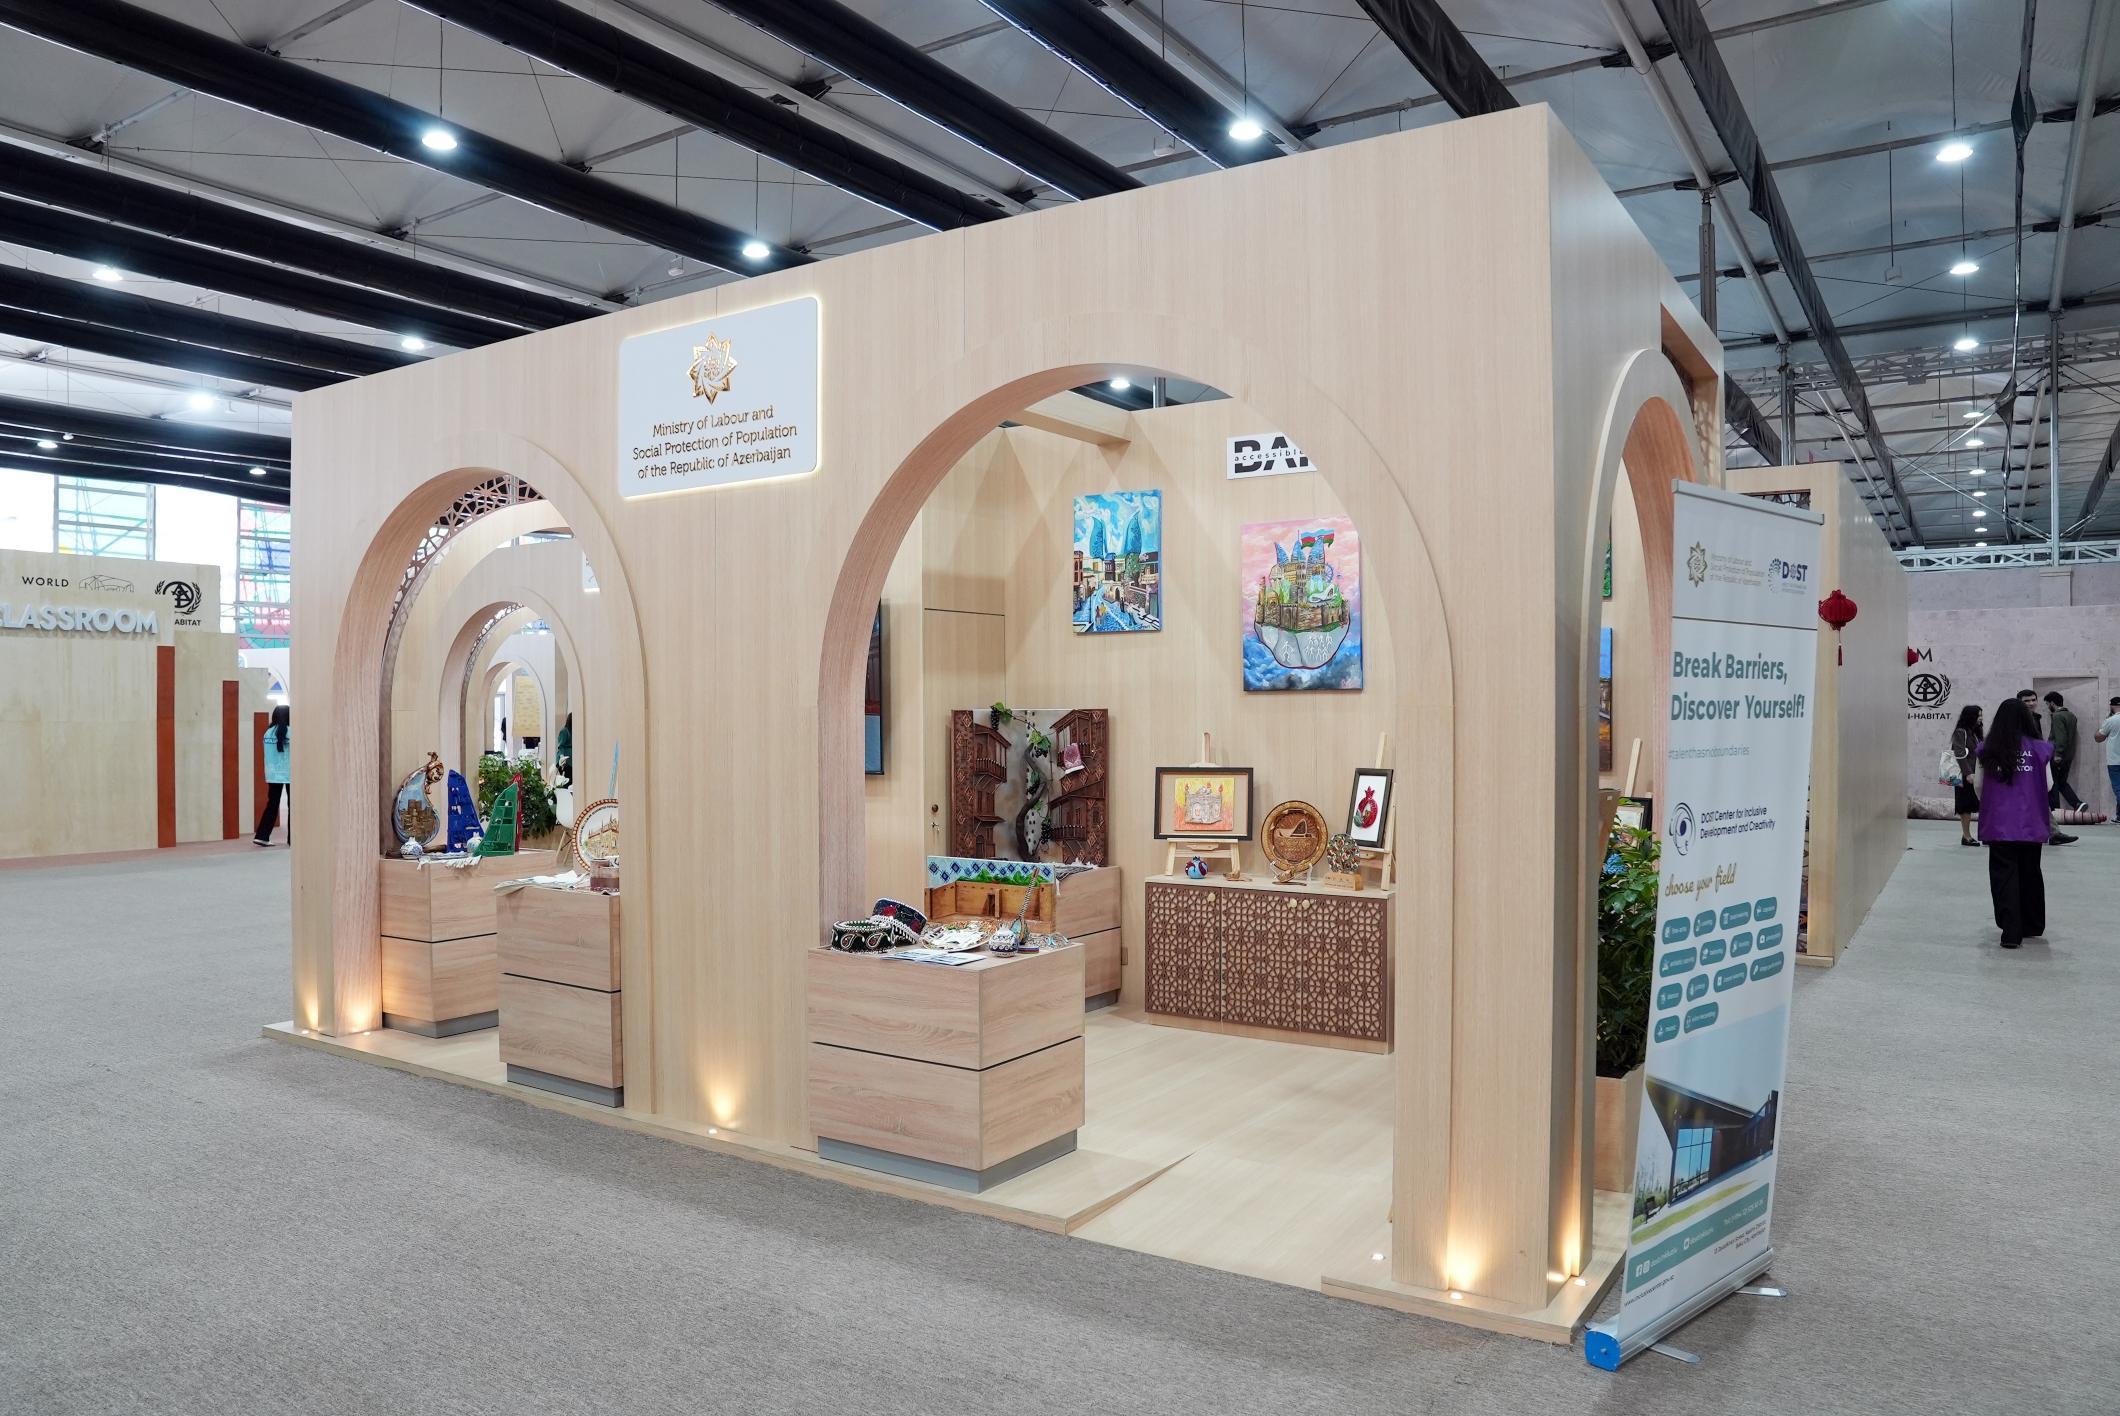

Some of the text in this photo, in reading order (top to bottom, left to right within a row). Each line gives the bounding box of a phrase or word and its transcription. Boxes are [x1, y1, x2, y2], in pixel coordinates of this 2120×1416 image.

[652, 405, 774, 437] Ministry of Labour and
[632, 424, 798, 461] Social Protection of Population
[637, 446, 791, 480] of the Republic of Azerbaijan
[22, 576, 69, 588] WORLD
[0, 603, 159, 634] LASSROOM
[174, 618, 201, 627] ABITAT
[1673, 651, 1787, 685] Break Barriers,
[1671, 691, 1805, 720] Discover Yourself!
[1700, 819, 1776, 839] Development and Creativity
[1714, 809, 1735, 821] Center
[1736, 808, 1744, 818] for
[1744, 806, 1767, 817] Inclusive
[1665, 862, 1737, 901] choose your field
